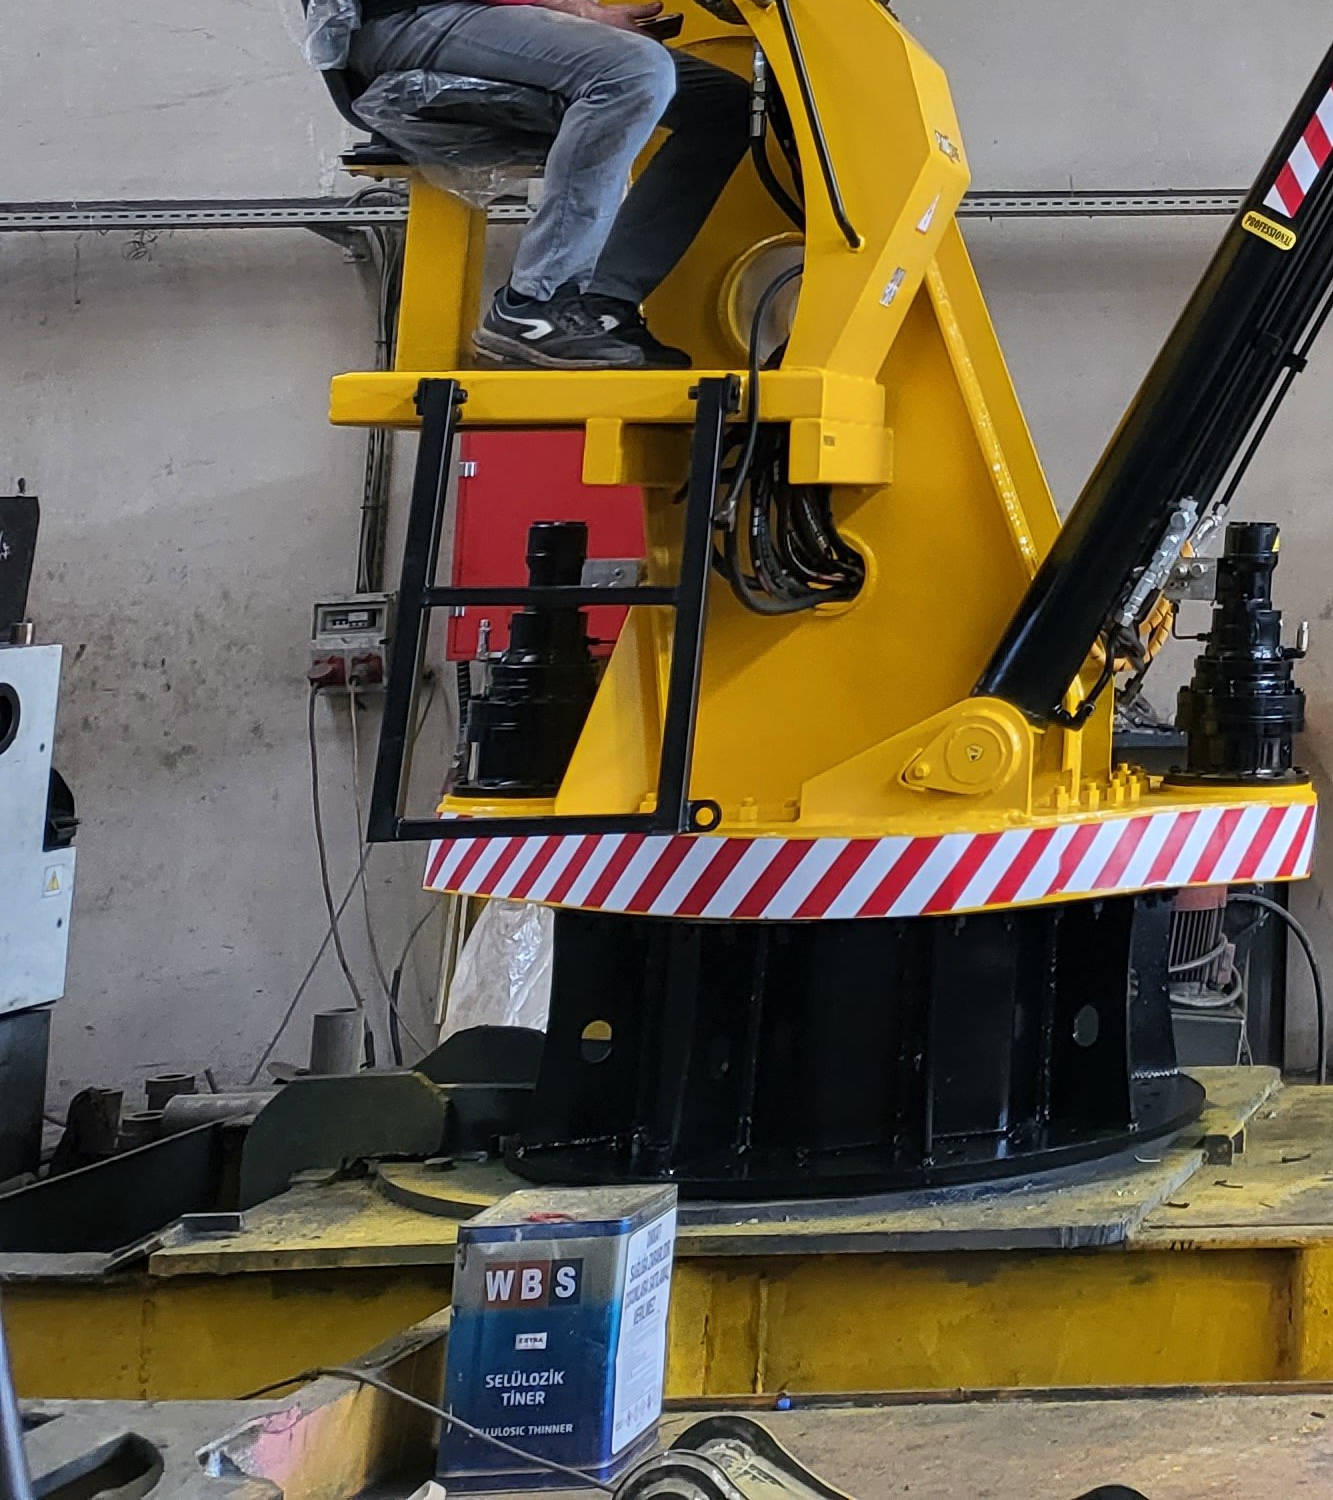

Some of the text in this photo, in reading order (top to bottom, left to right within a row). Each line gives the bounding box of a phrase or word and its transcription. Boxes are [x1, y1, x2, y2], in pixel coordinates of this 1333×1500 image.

[485, 1266, 577, 1302] WBS
[485, 1368, 565, 1389] SELÜLOZİK
[501, 1389, 546, 1407] TİNER
[528, 1423, 573, 1435] THINNER
